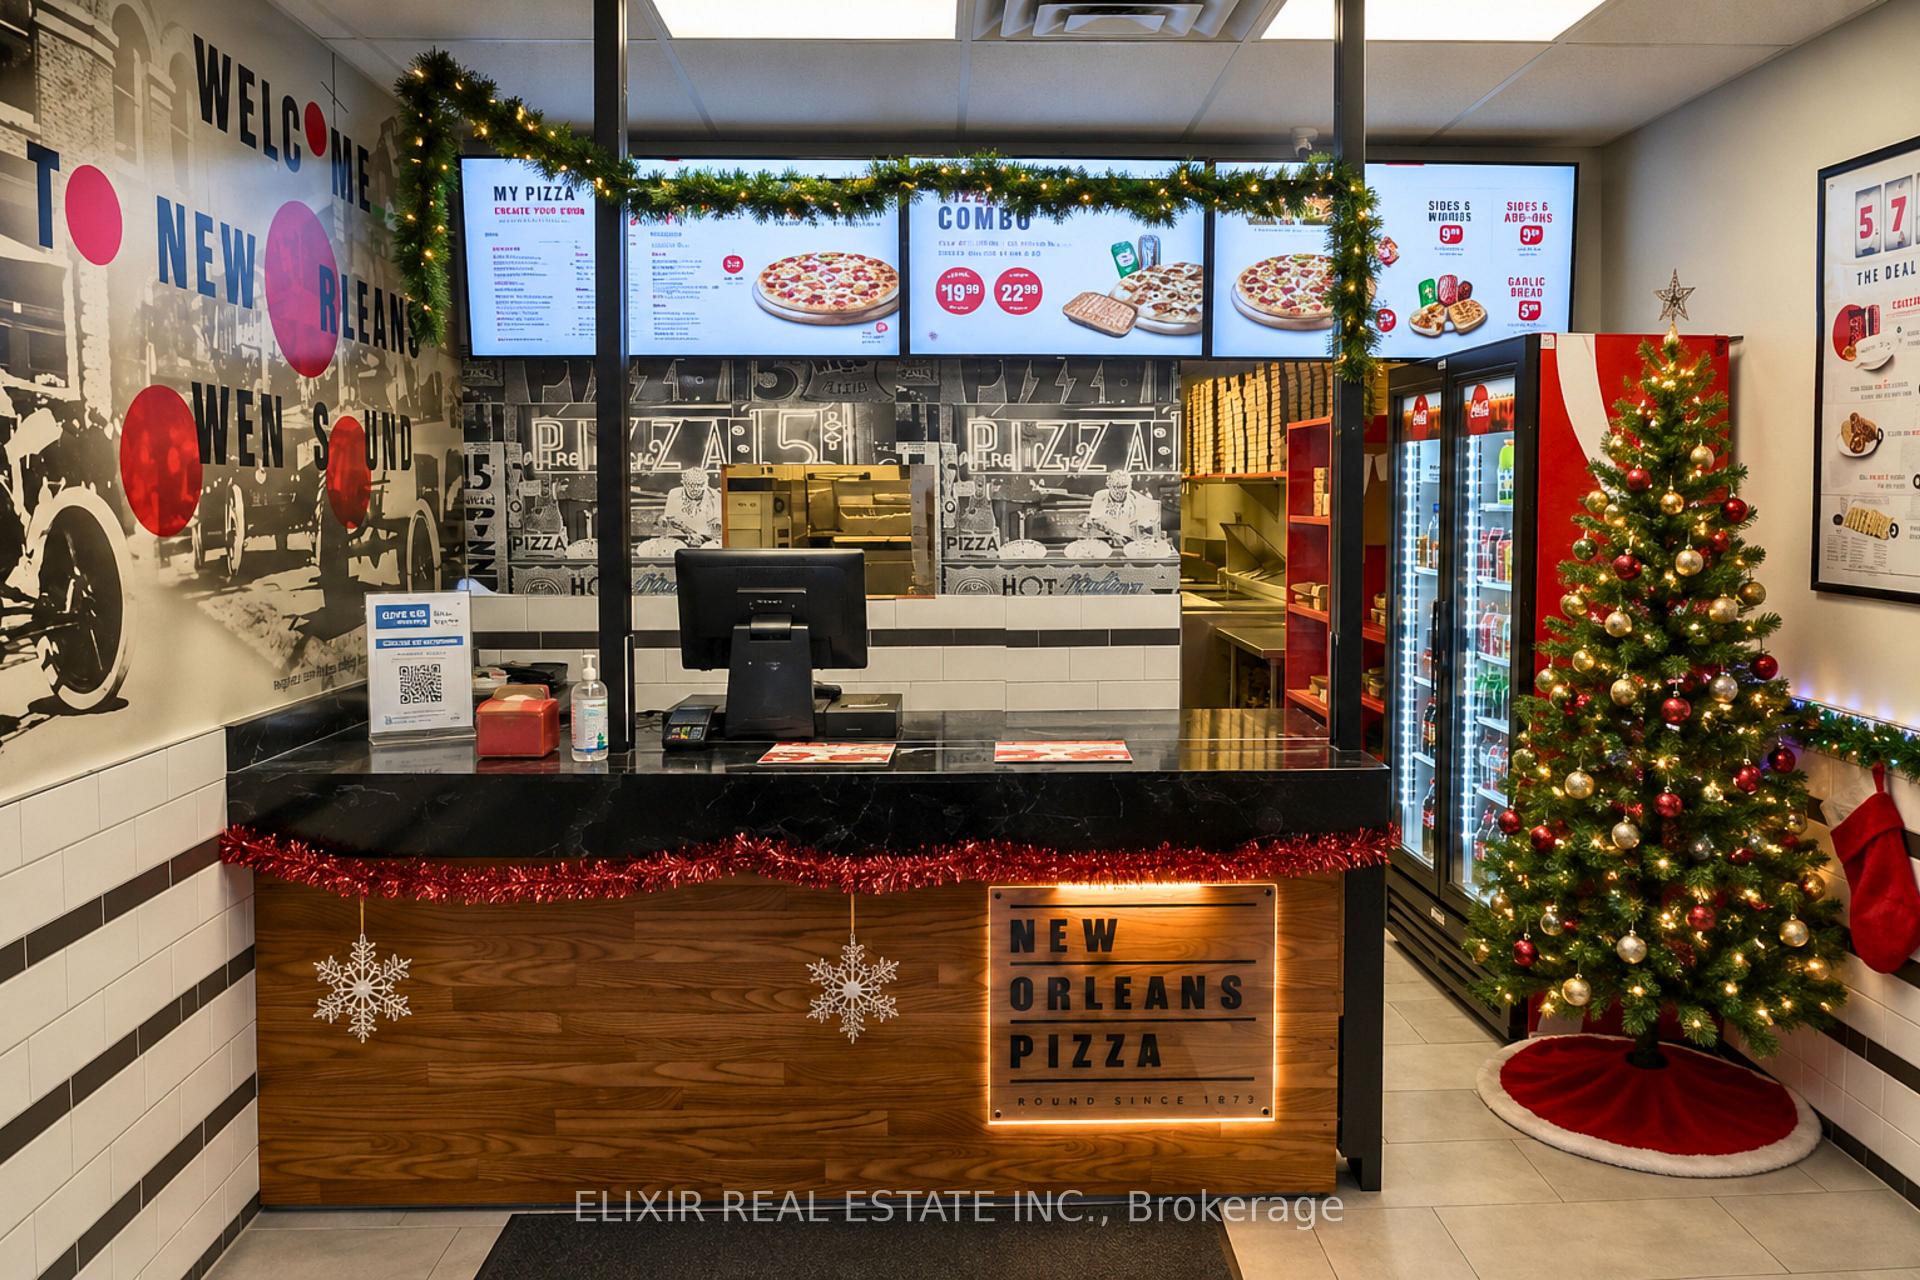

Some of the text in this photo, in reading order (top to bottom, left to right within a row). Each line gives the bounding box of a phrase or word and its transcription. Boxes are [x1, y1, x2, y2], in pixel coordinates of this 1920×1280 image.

[494, 186, 575, 201] MY PIZZA
[156, 195, 256, 310] NEW
[1857, 260, 1917, 286] THE DEAL
[512, 536, 567, 551] PIZZA
[946, 536, 999, 551] PIZZA
[1010, 918, 1118, 953] NEW
[1010, 975, 1243, 1012] ORLEANS
[1010, 1033, 1162, 1069] PIZZA
[1018, 1096, 1095, 1106] ROUND
[1114, 1095, 1185, 1106] SINCE
